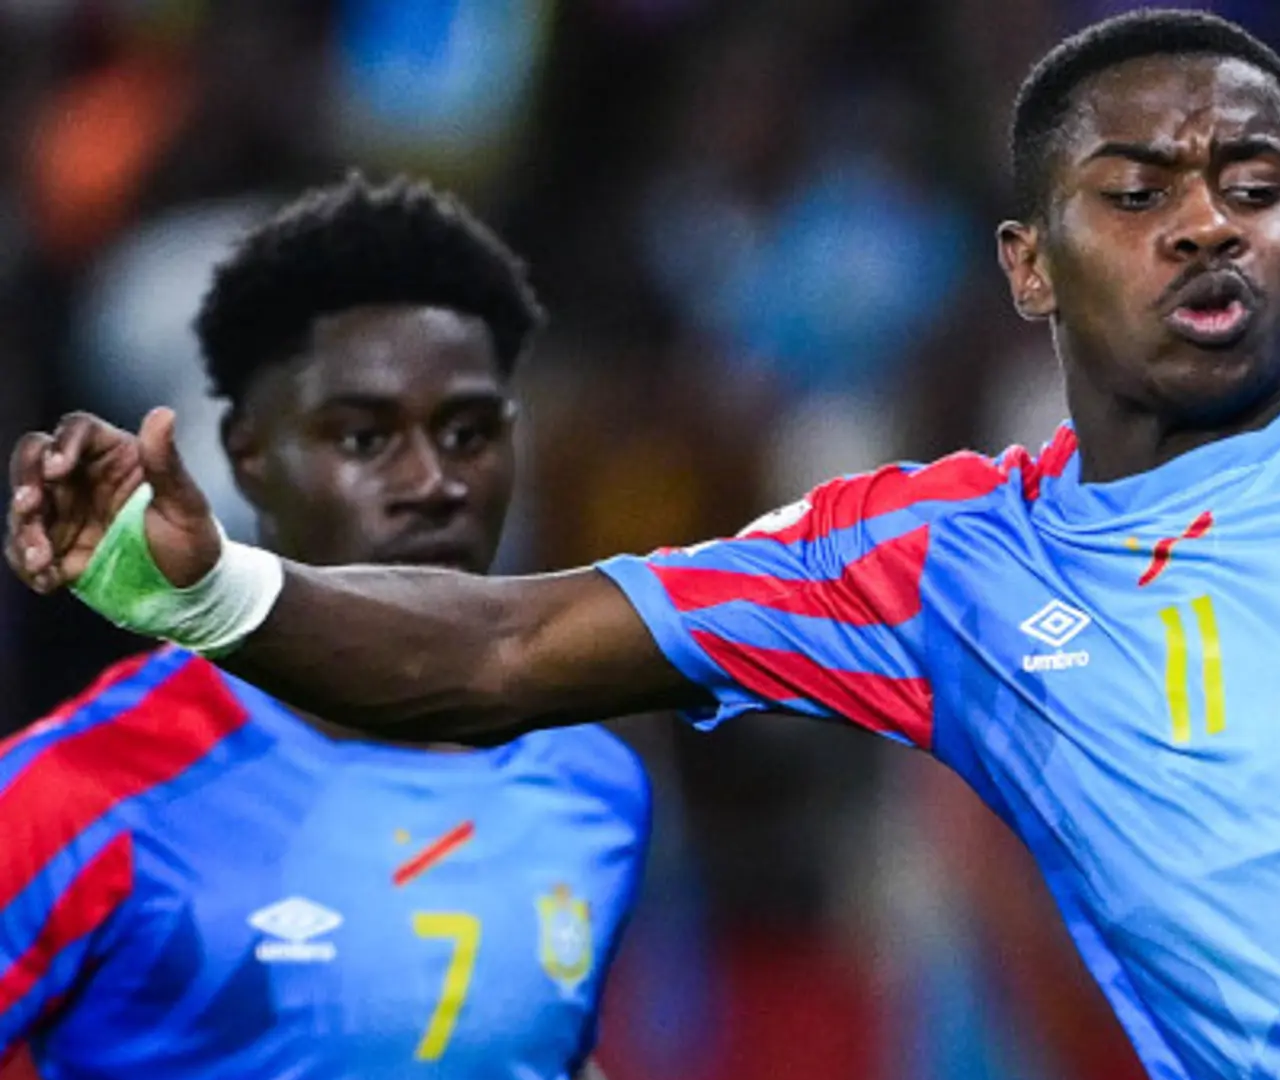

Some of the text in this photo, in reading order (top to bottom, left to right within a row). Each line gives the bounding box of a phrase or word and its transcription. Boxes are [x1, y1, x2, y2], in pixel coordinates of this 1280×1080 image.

[1023, 648, 1089, 671] umbro
[1158, 594, 1226, 743] 11
[413, 912, 481, 1061] 7
